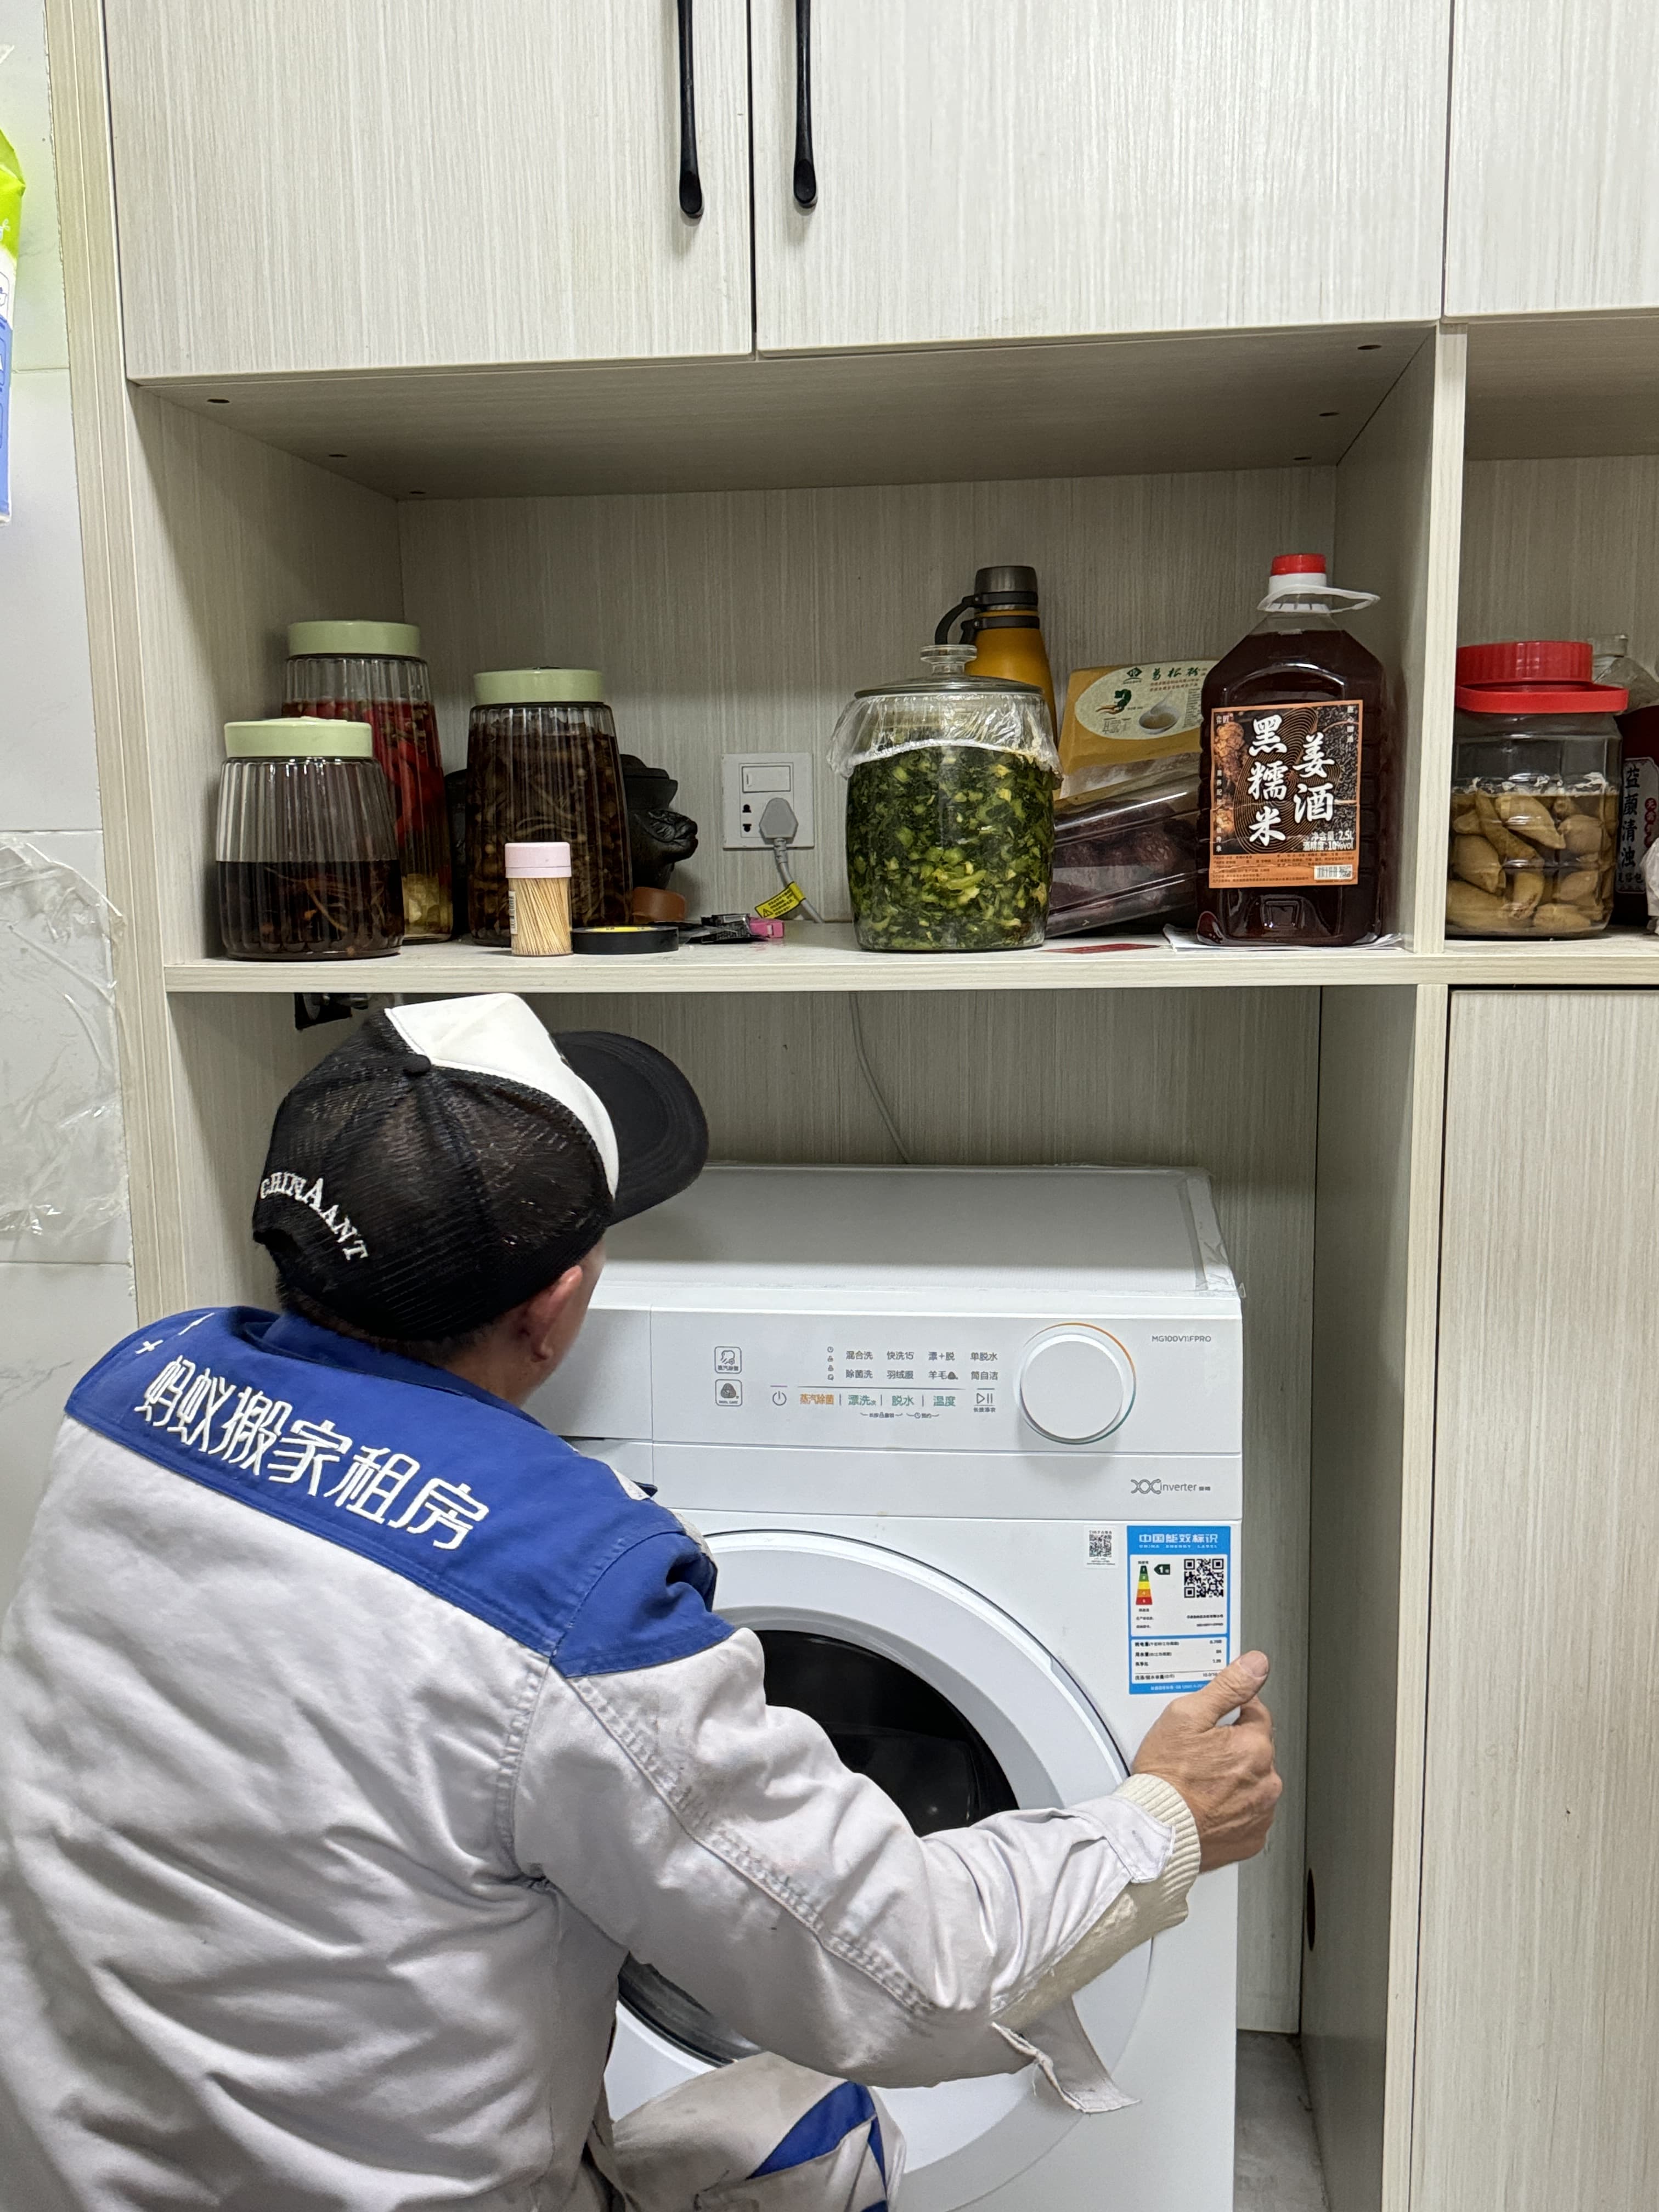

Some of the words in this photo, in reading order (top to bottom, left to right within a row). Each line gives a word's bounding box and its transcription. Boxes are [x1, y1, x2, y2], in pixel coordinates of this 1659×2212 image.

[1248, 714, 1288, 846] 黑糯米
[1293, 732, 1335, 823] 姜酒
[260, 1171, 324, 1212] CHINA
[319, 1204, 369, 1260] ANT
[845, 1350, 873, 1360] 混合洗
[887, 1351, 915, 1361] 快洗15
[928, 1351, 955, 1361] 漂+脱
[970, 1351, 998, 1361] 单脱水
[845, 1369, 873, 1379] 除菌洗
[887, 1370, 914, 1379] 羽绒服
[928, 1370, 947, 1380] 羊毛
[970, 1370, 998, 1380] 筒自洁
[799, 1393, 834, 1405] 蒸汽除菌
[891, 1395, 915, 1407] 脱水
[933, 1395, 956, 1407] 温度
[134, 1354, 490, 1550] 蚂蚁搬家租房
[1139, 1533, 1218, 1544] 中国能效标识
